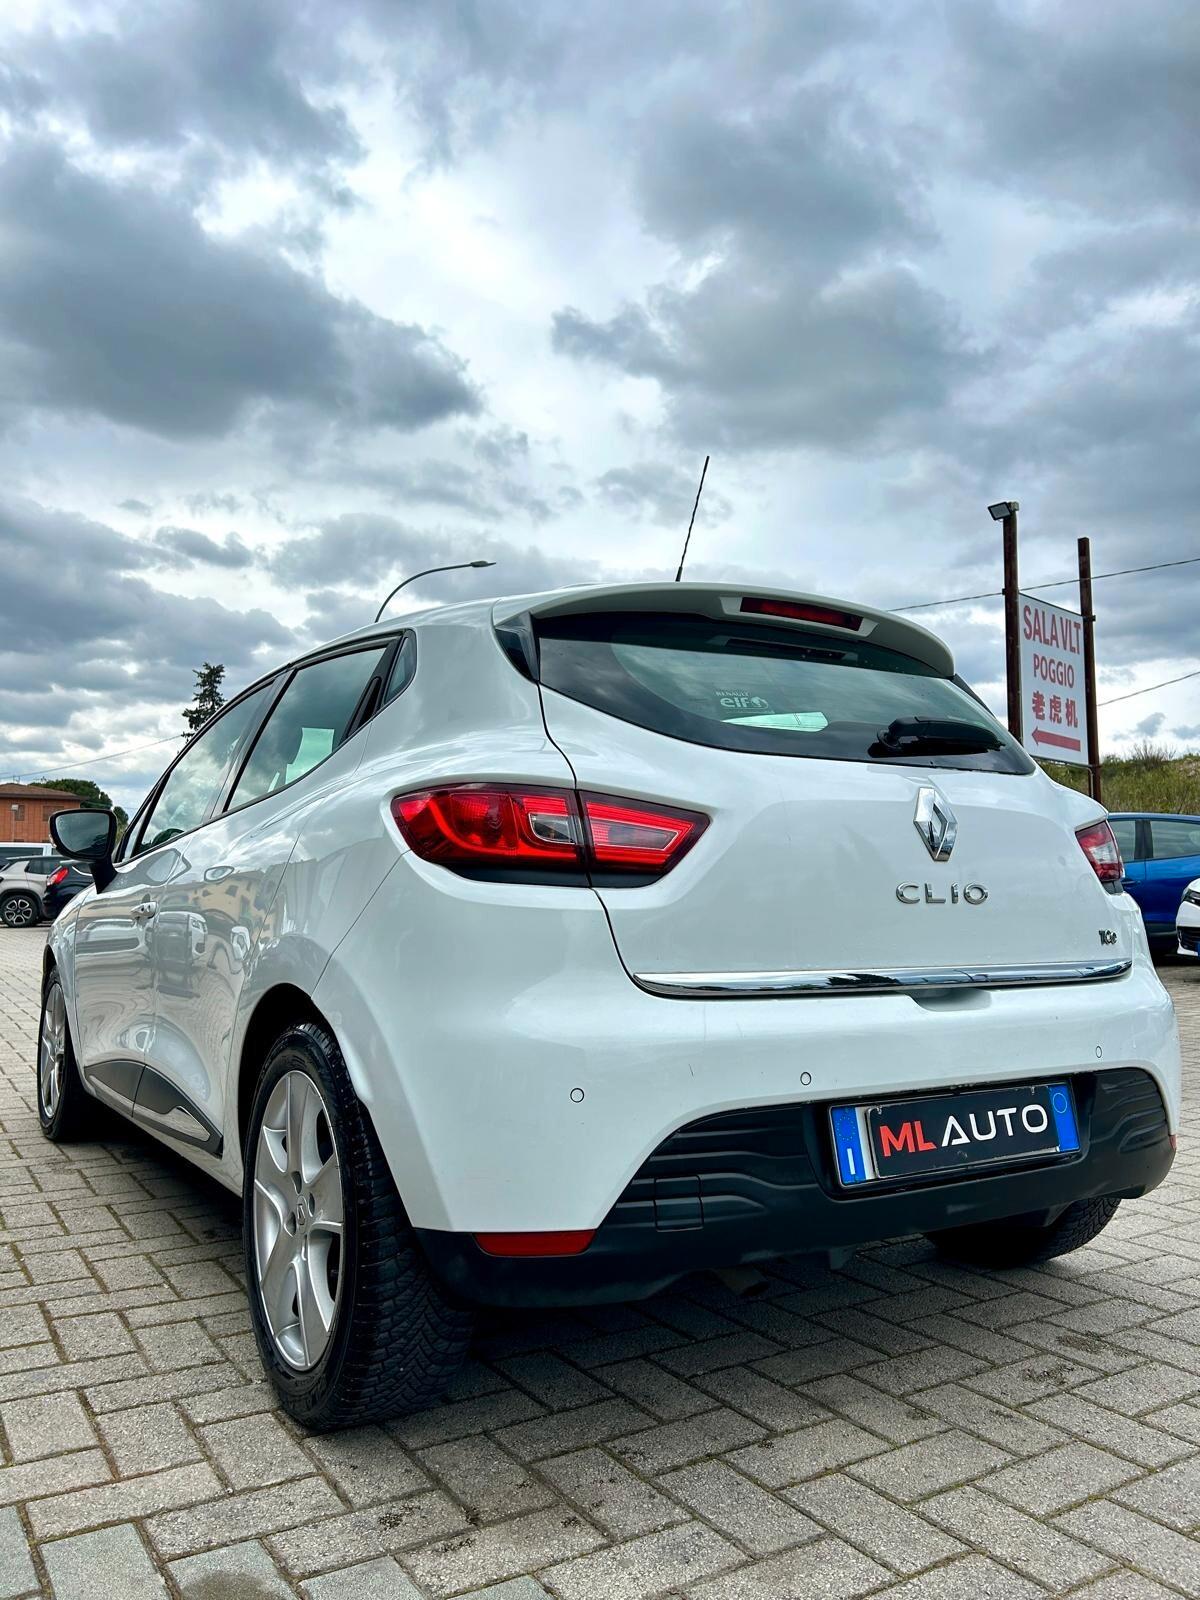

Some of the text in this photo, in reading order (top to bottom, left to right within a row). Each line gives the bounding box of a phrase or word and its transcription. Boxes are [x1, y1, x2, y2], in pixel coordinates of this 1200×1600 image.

[1023, 605, 1081, 654] SALA VLT
[1033, 653, 1074, 688] POGGIO
[720, 697, 749, 708] elf
[1032, 691, 1078, 728] 老虎机
[895, 881, 989, 905] CLIO
[941, 1104, 1049, 1147] AUTO
[846, 1148, 856, 1175] I
